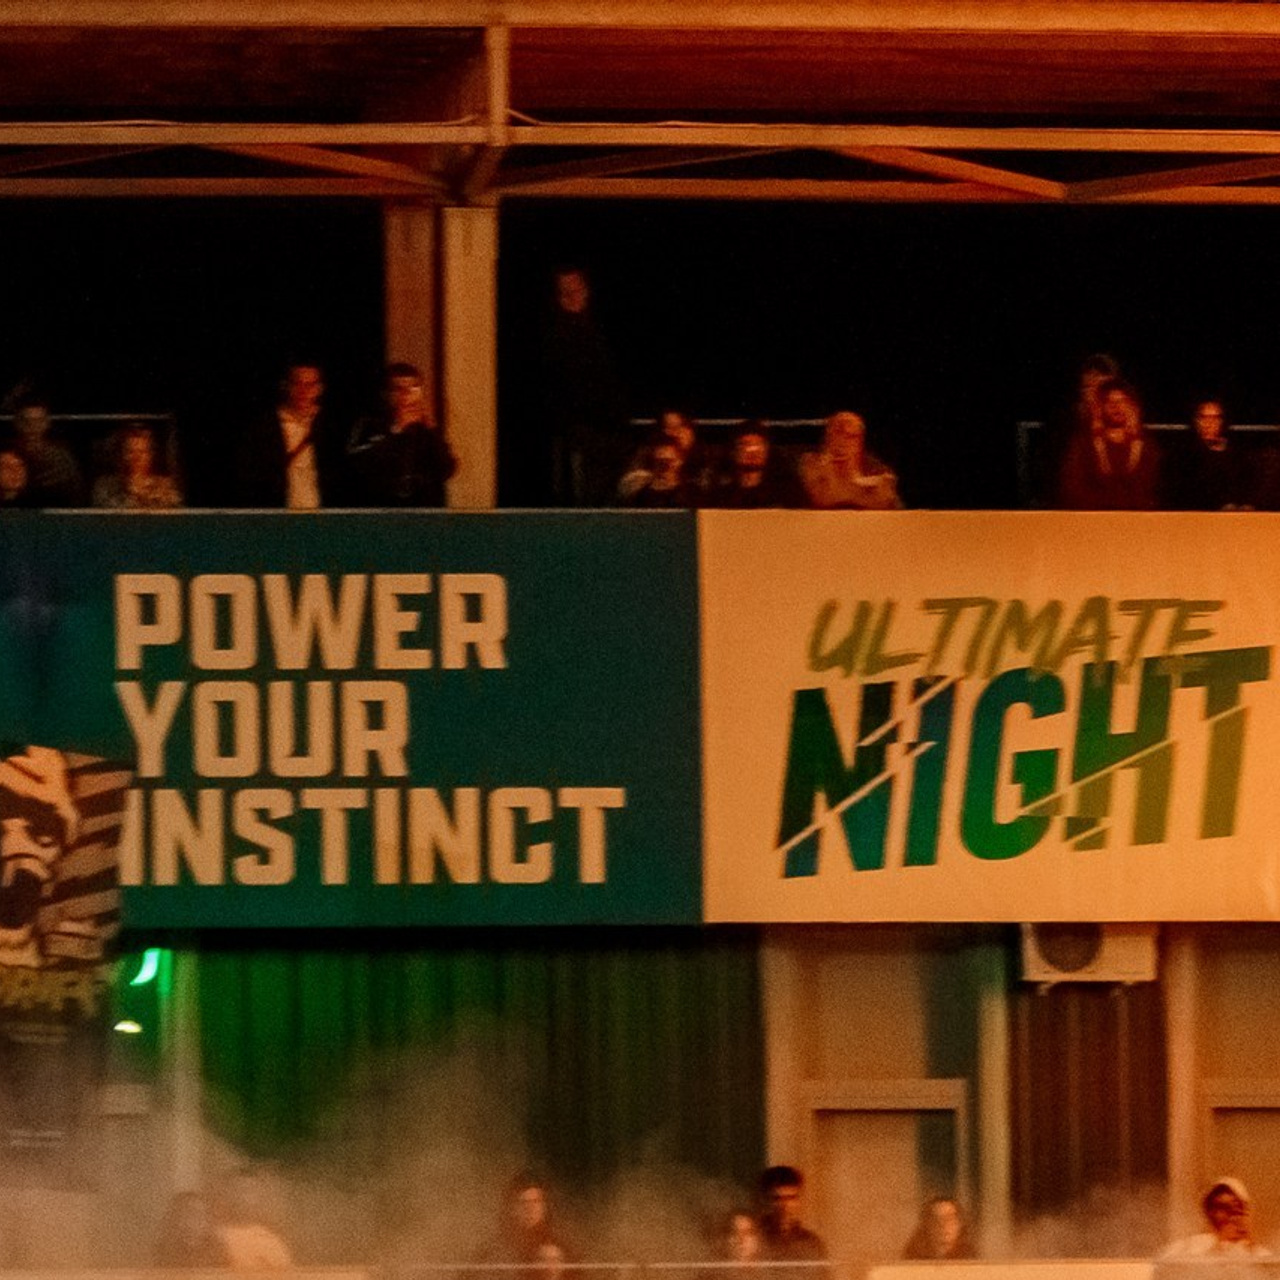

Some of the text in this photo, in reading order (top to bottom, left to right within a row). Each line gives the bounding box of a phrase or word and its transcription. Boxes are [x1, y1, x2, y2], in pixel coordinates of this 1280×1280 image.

[114, 573, 508, 669] POWER
[806, 596, 1226, 680] ULTIMATE
[114, 681, 408, 777] YOUR
[777, 645, 1276, 879] NIGHT
[118, 787, 625, 885] INSTINCT
